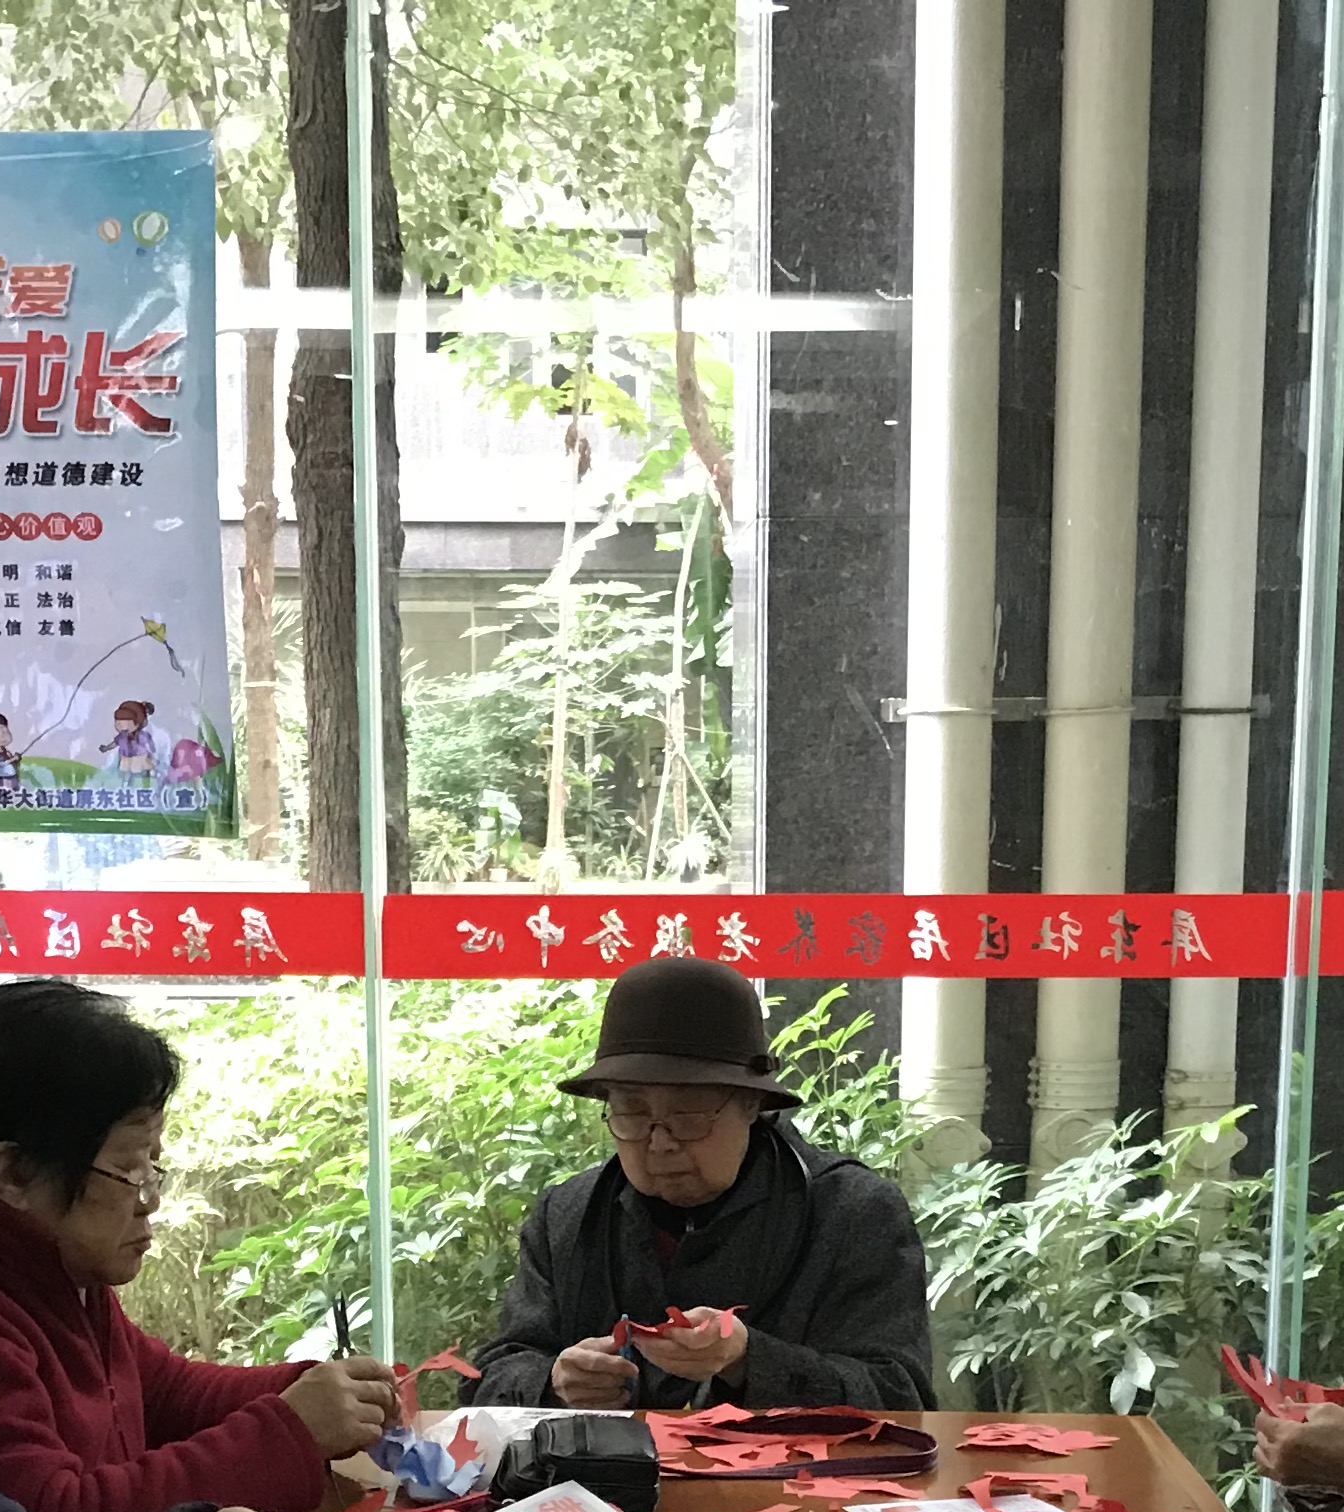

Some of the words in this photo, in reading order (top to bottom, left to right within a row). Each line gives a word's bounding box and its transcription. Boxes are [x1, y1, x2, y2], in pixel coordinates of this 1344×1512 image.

[34, 563, 73, 582] 和谐
[36, 591, 75, 609] 法治
[37, 619, 76, 637] 友善
